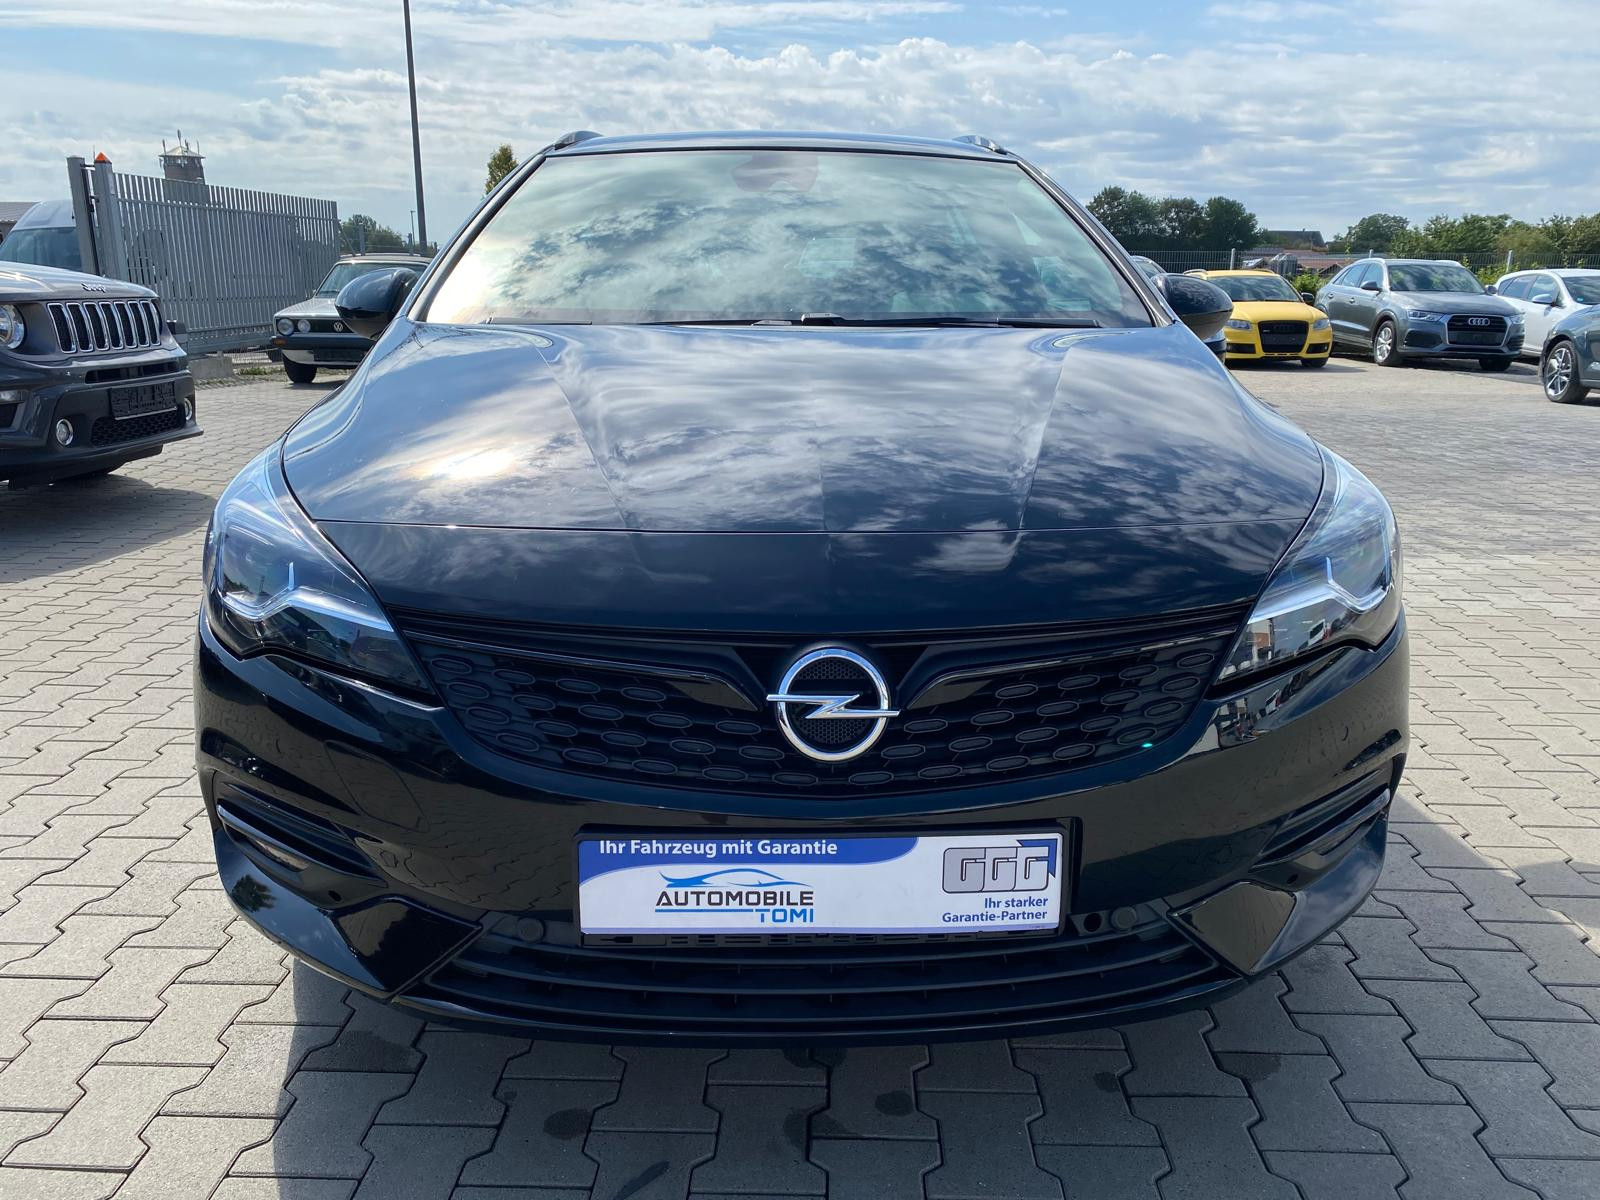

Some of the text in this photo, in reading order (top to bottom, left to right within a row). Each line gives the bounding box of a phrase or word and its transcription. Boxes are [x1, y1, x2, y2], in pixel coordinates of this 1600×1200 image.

[599, 840, 838, 858] Ihr Fahrzeug mit Garantie
[942, 846, 1049, 894] GGG
[655, 890, 814, 907] AUTOMOBILE
[984, 897, 1048, 909] Ihr starker
[755, 908, 814, 923] TOMI
[942, 911, 1048, 923] Garantie-Partner
